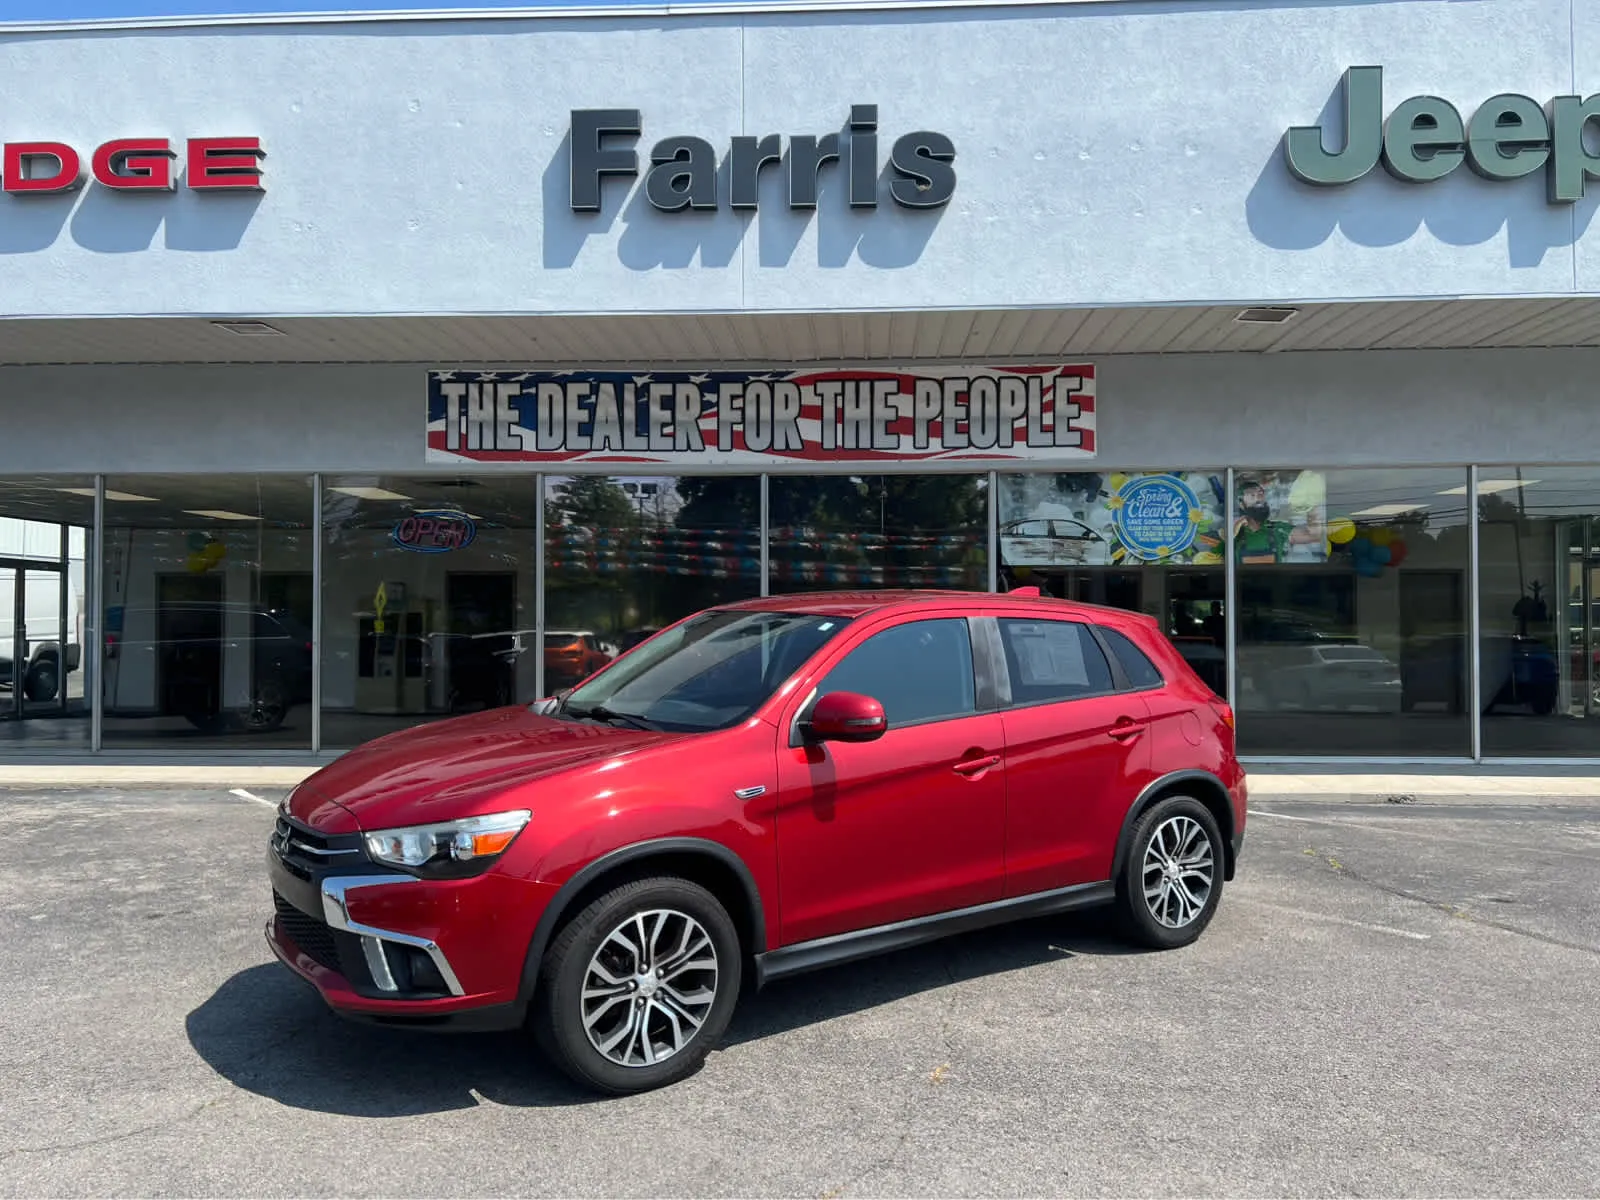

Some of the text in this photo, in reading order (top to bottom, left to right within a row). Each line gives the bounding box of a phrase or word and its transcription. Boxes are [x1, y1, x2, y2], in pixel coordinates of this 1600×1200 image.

[569, 104, 957, 213] Farris
[440, 375, 1083, 453] THE DEALER FOR THE PEOPLE
[1127, 498, 1183, 518] Clean &
[1137, 488, 1173, 507] Spring
[400, 516, 465, 549] OPEN
